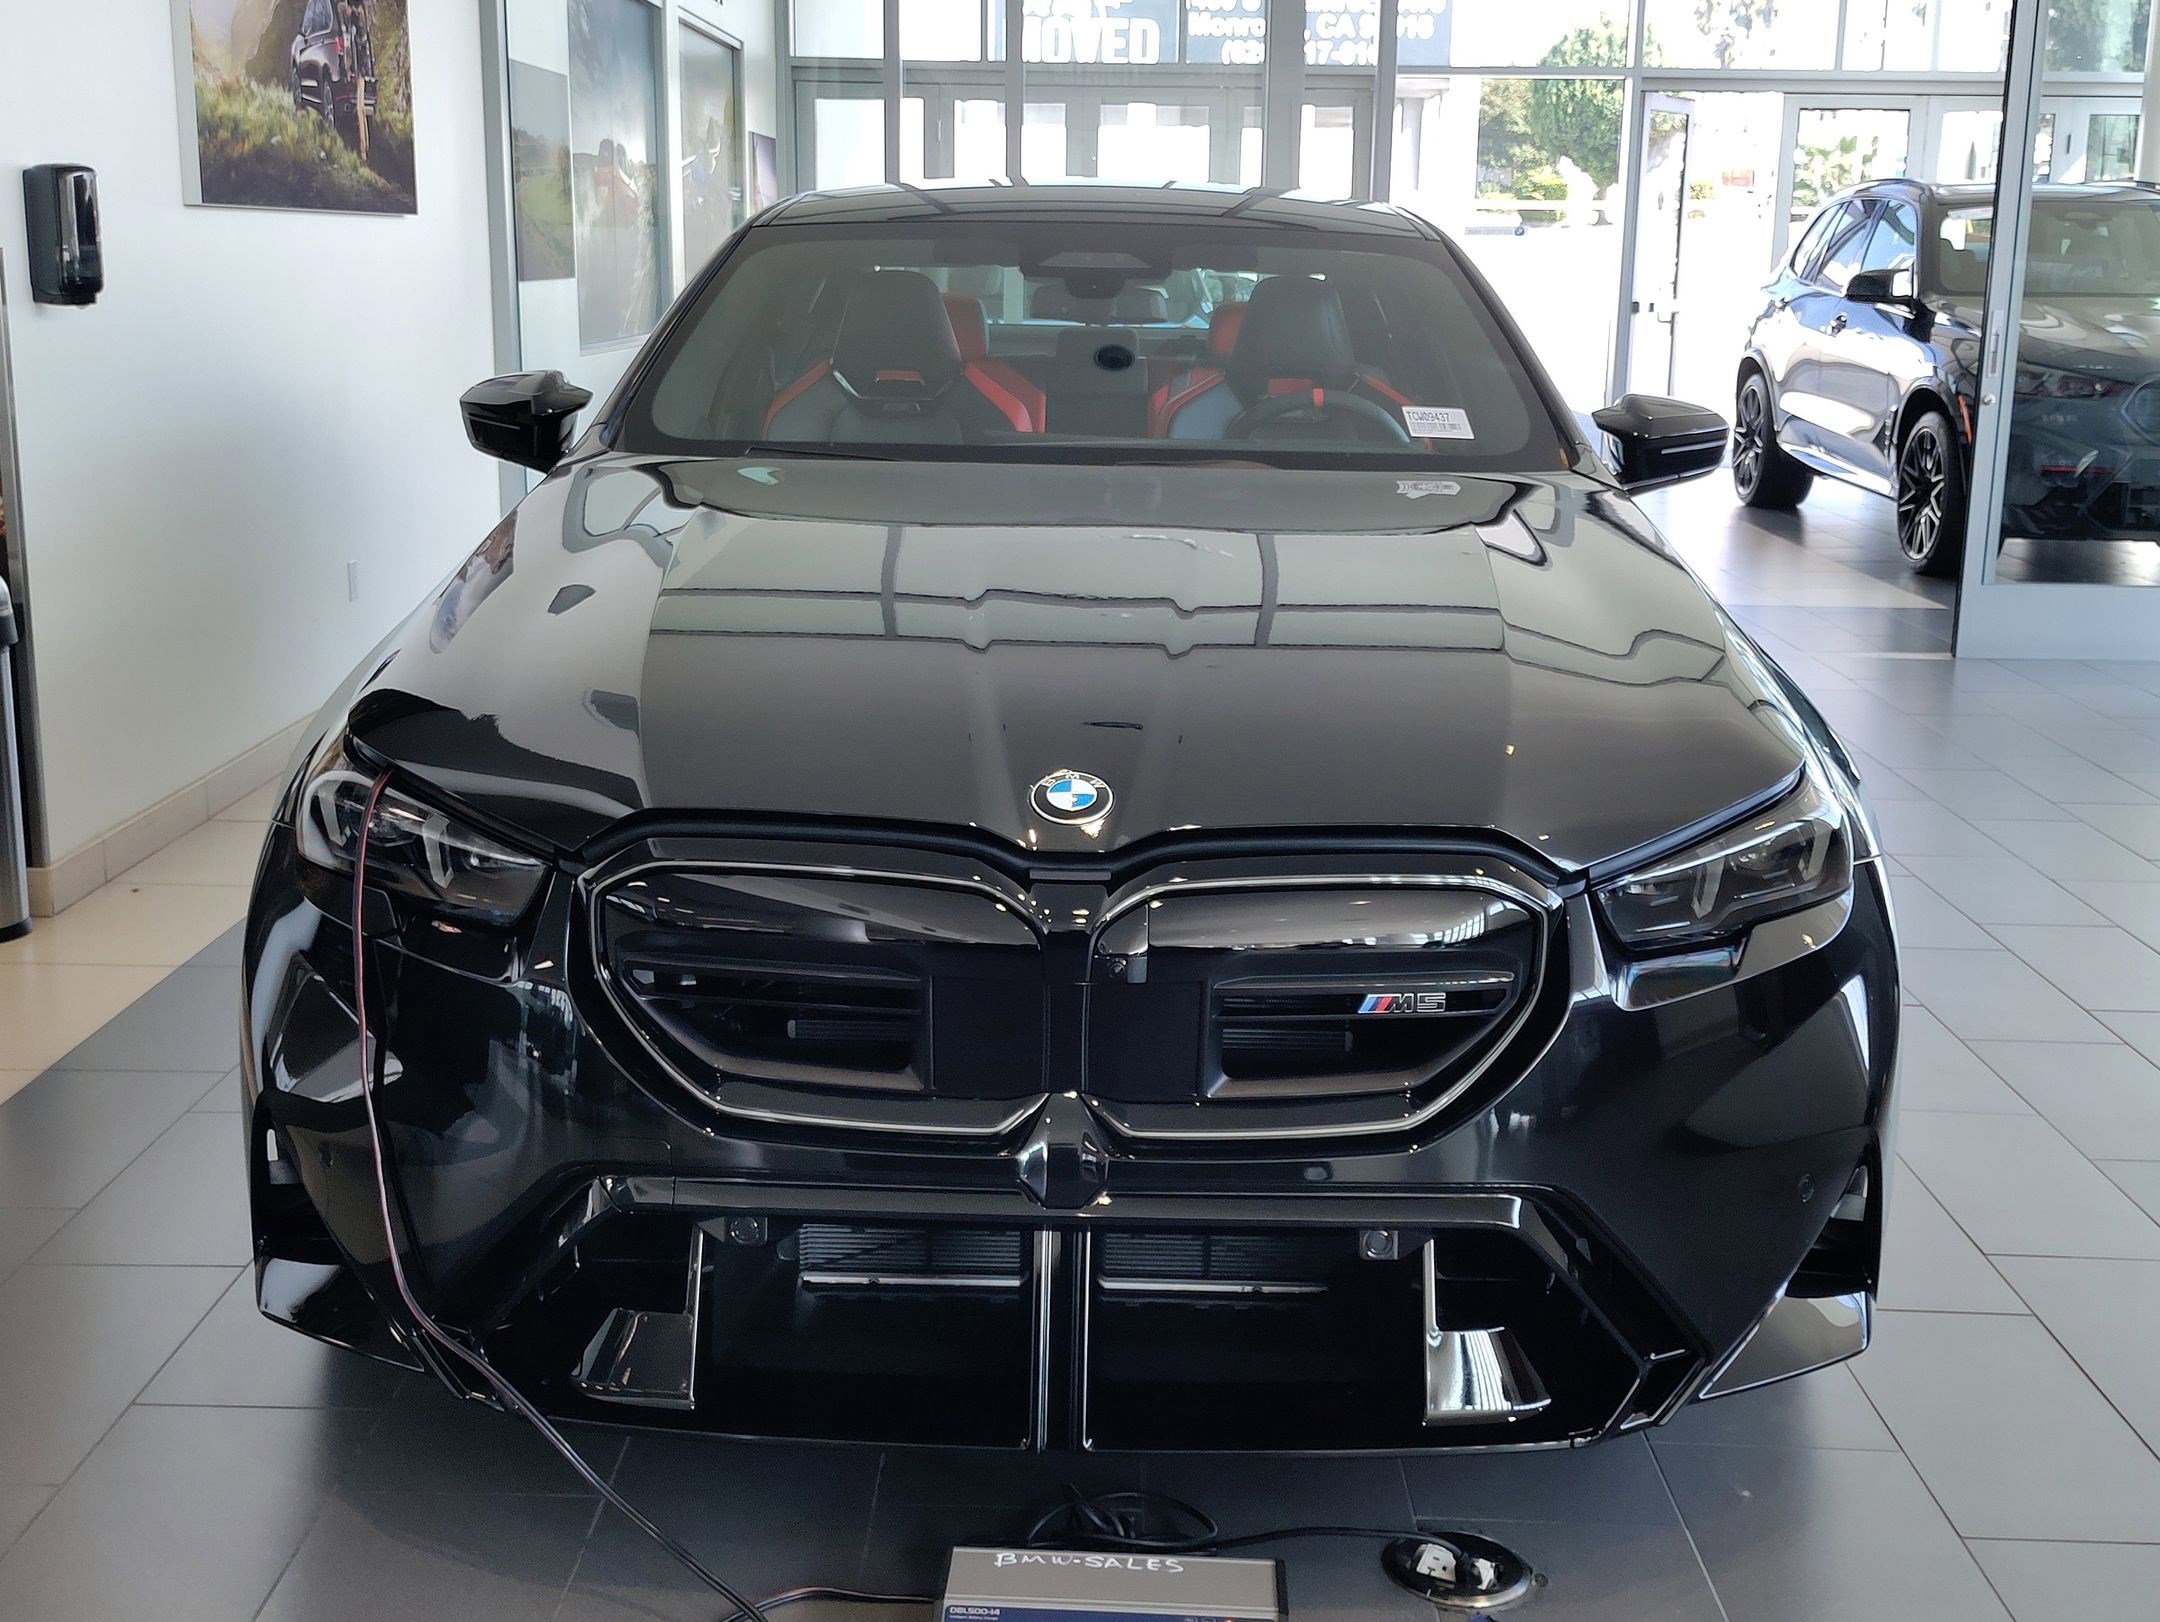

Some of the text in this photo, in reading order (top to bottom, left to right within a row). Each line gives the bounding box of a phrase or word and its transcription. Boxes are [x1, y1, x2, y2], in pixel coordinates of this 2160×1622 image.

[1316, 12, 1357, 39] CA
[1041, 774, 1106, 788] BMW
[994, 1552, 1184, 1574] BMW-SALES
